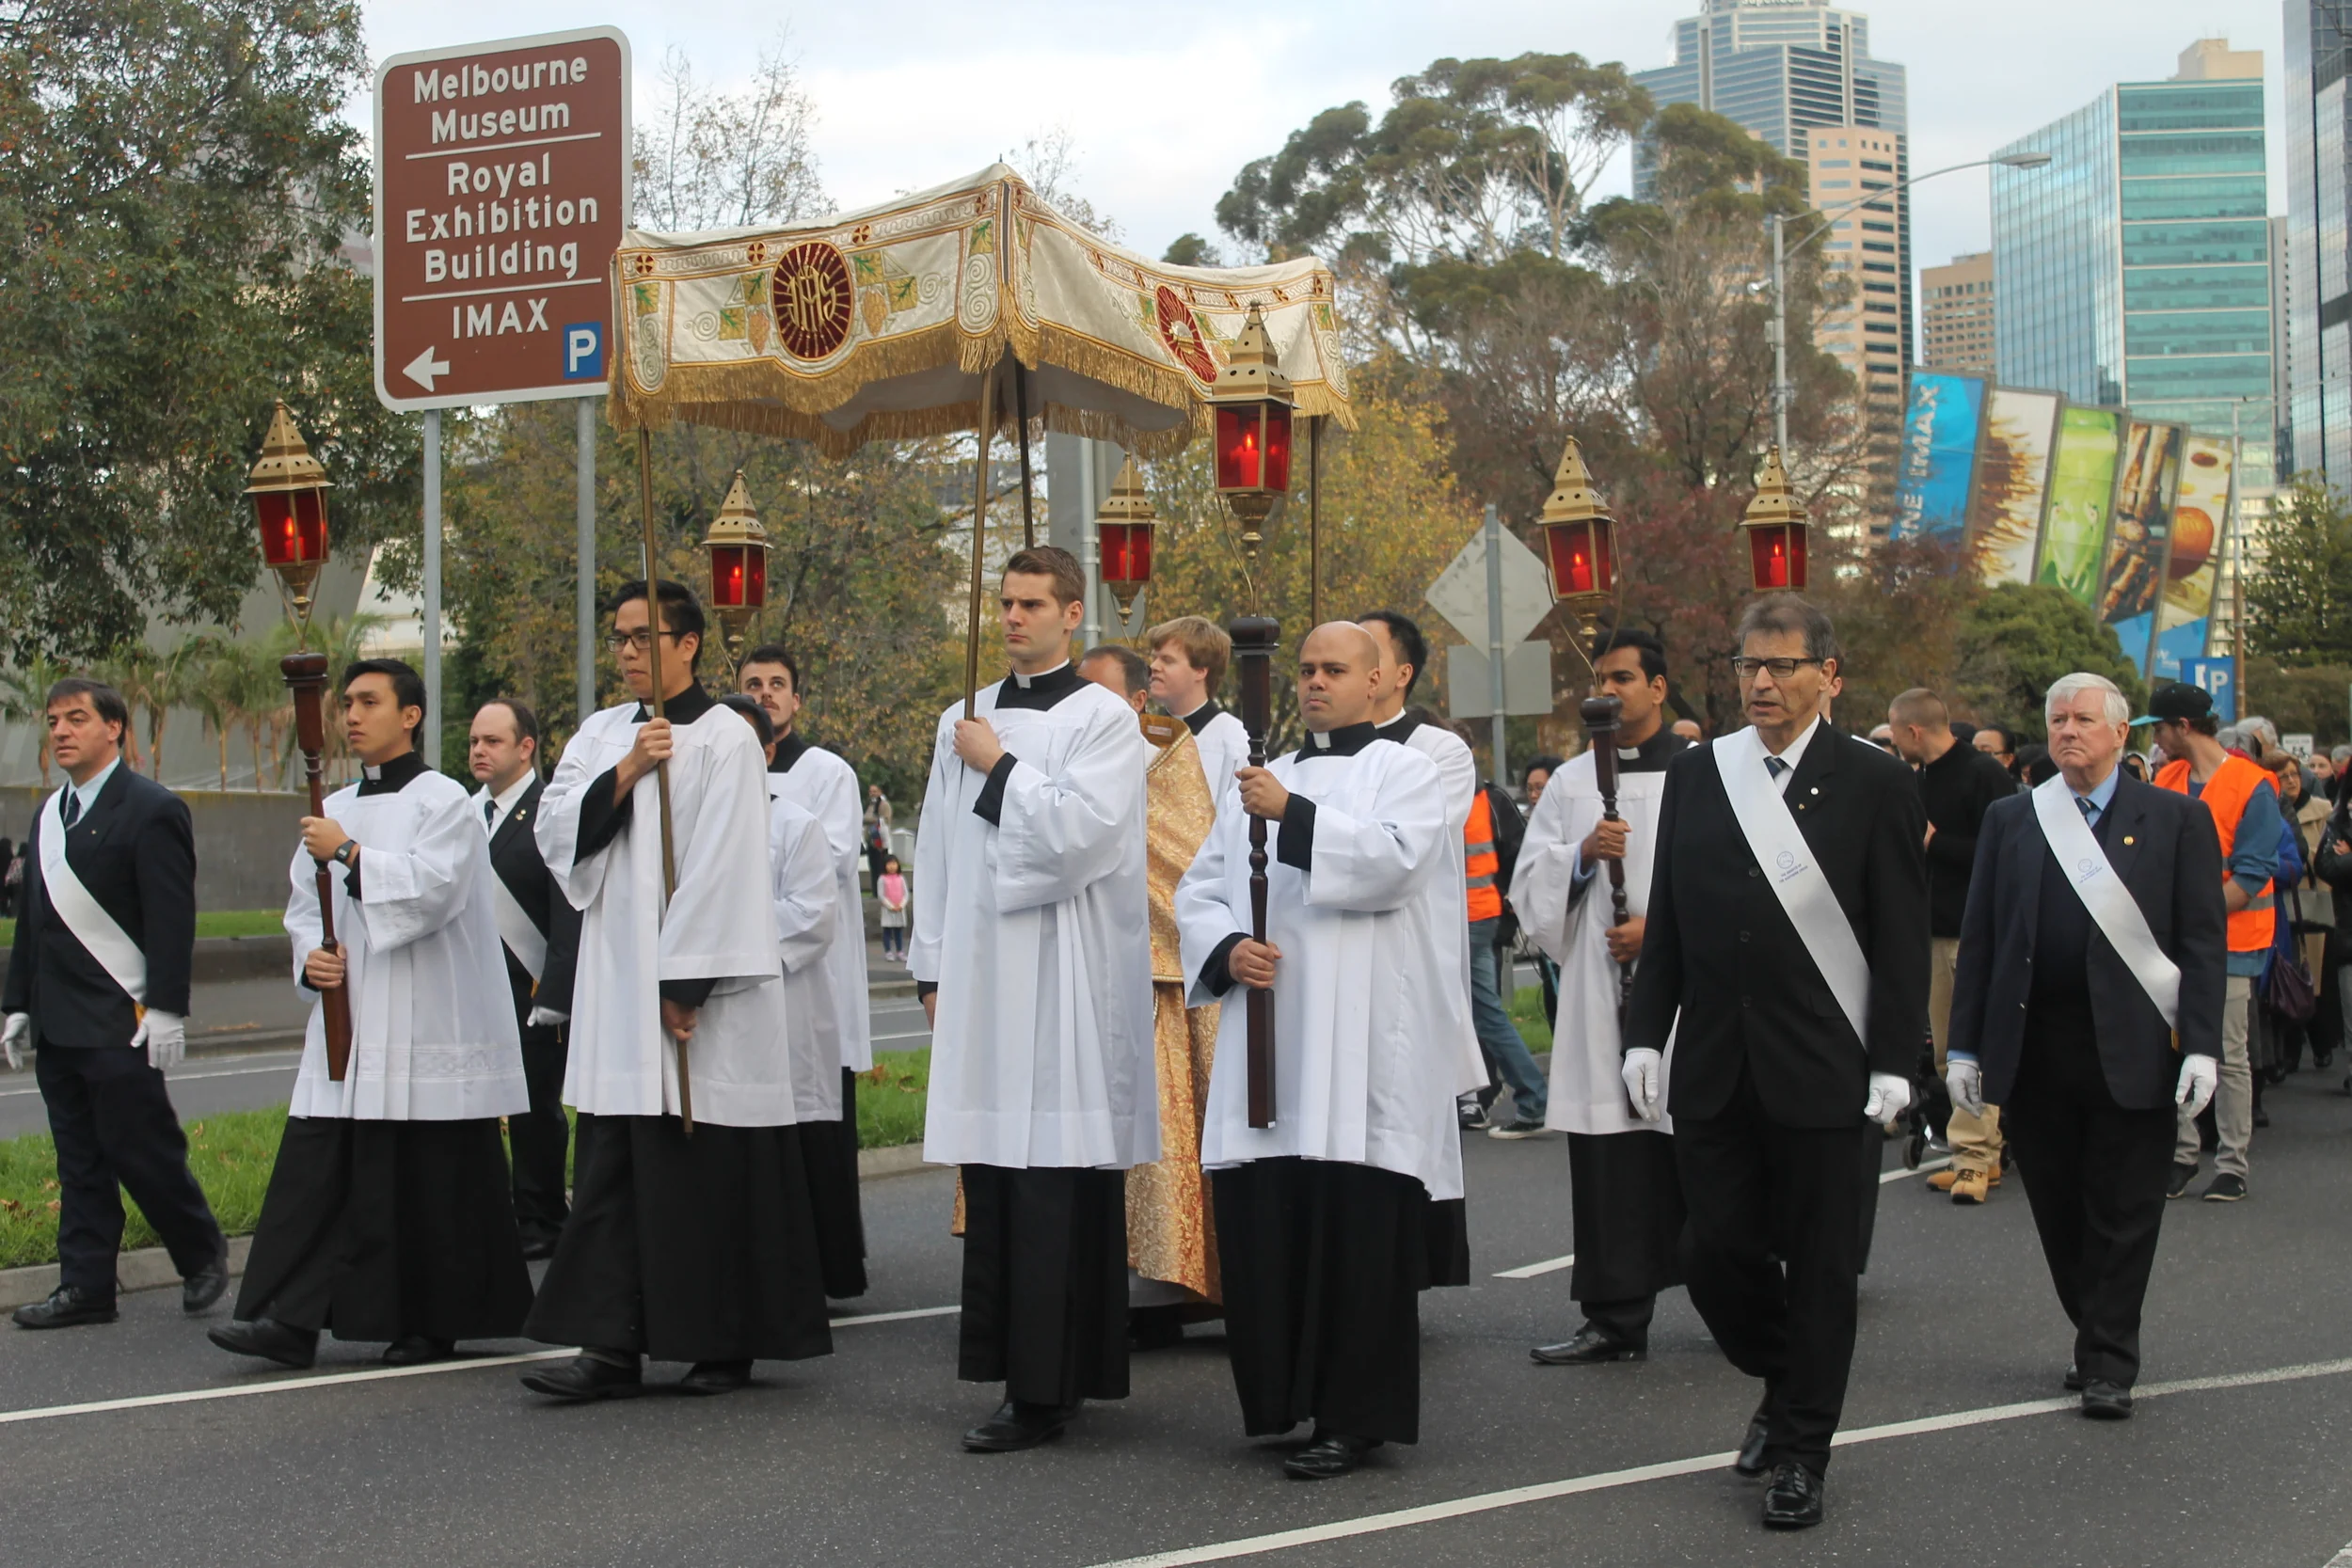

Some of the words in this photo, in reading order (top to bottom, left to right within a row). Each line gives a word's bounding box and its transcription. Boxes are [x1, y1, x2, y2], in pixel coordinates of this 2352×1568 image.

[414, 56, 588, 103] Melbourne
[432, 102, 569, 144] Museum
[448, 152, 549, 198] Royal
[406, 195, 598, 243] Exhibition
[425, 239, 578, 283] Building
[453, 297, 549, 340] IMAX
[569, 329, 597, 372] P
